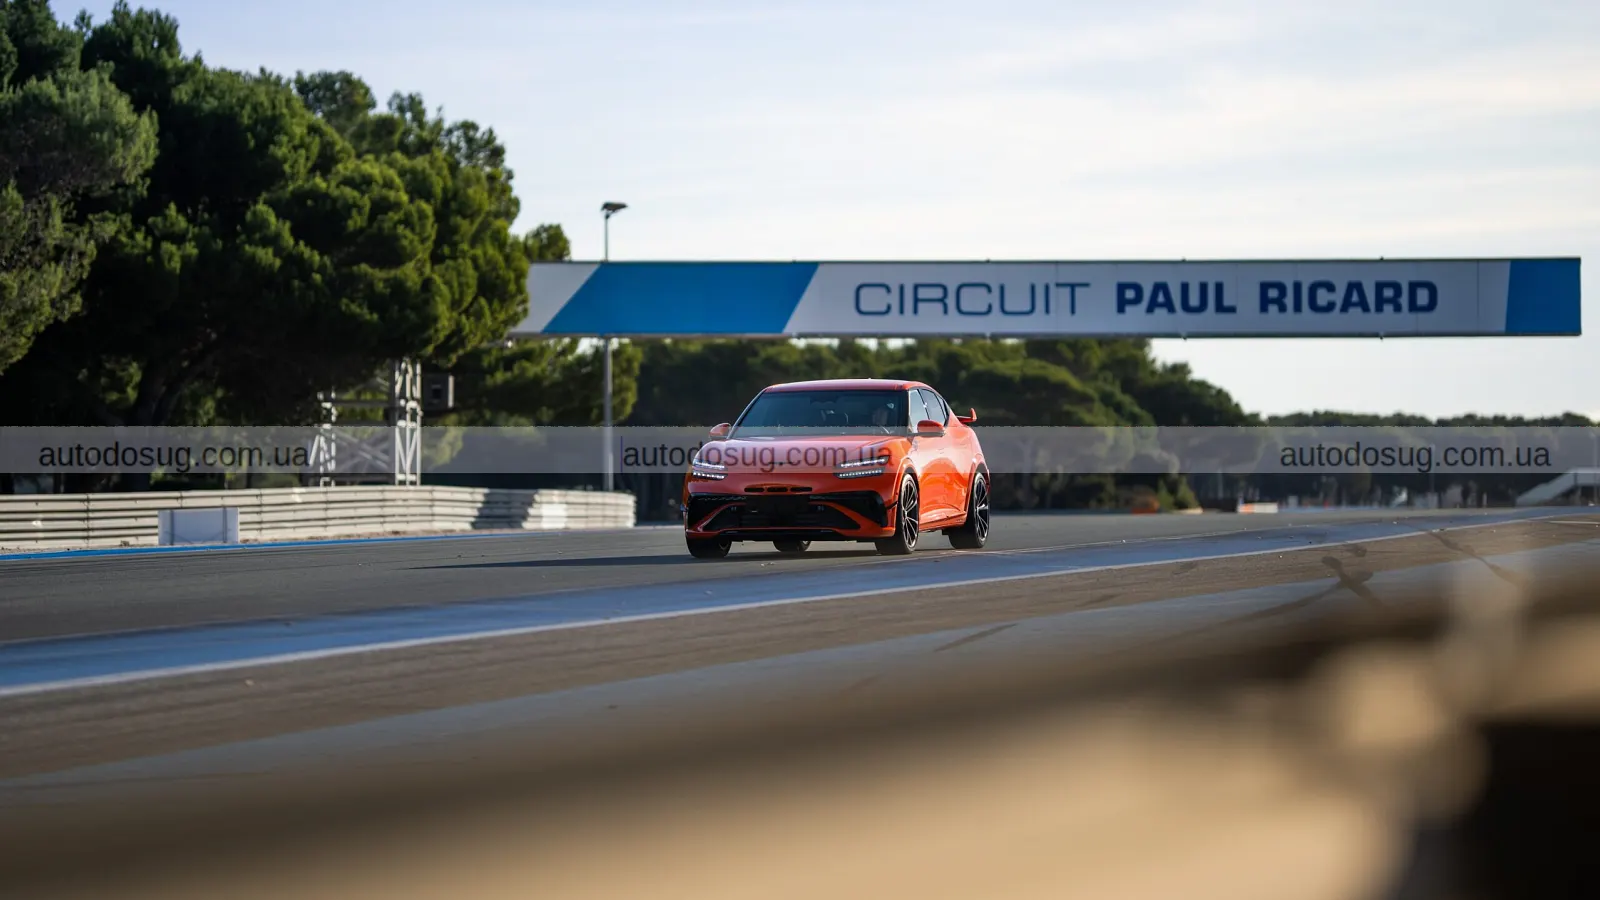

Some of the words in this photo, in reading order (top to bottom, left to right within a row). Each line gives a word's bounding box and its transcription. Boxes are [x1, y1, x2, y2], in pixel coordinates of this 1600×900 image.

[854, 282, 1090, 316] CIRCUIT
[1116, 281, 1236, 314] PAUL
[1259, 280, 1438, 313] RICARD
